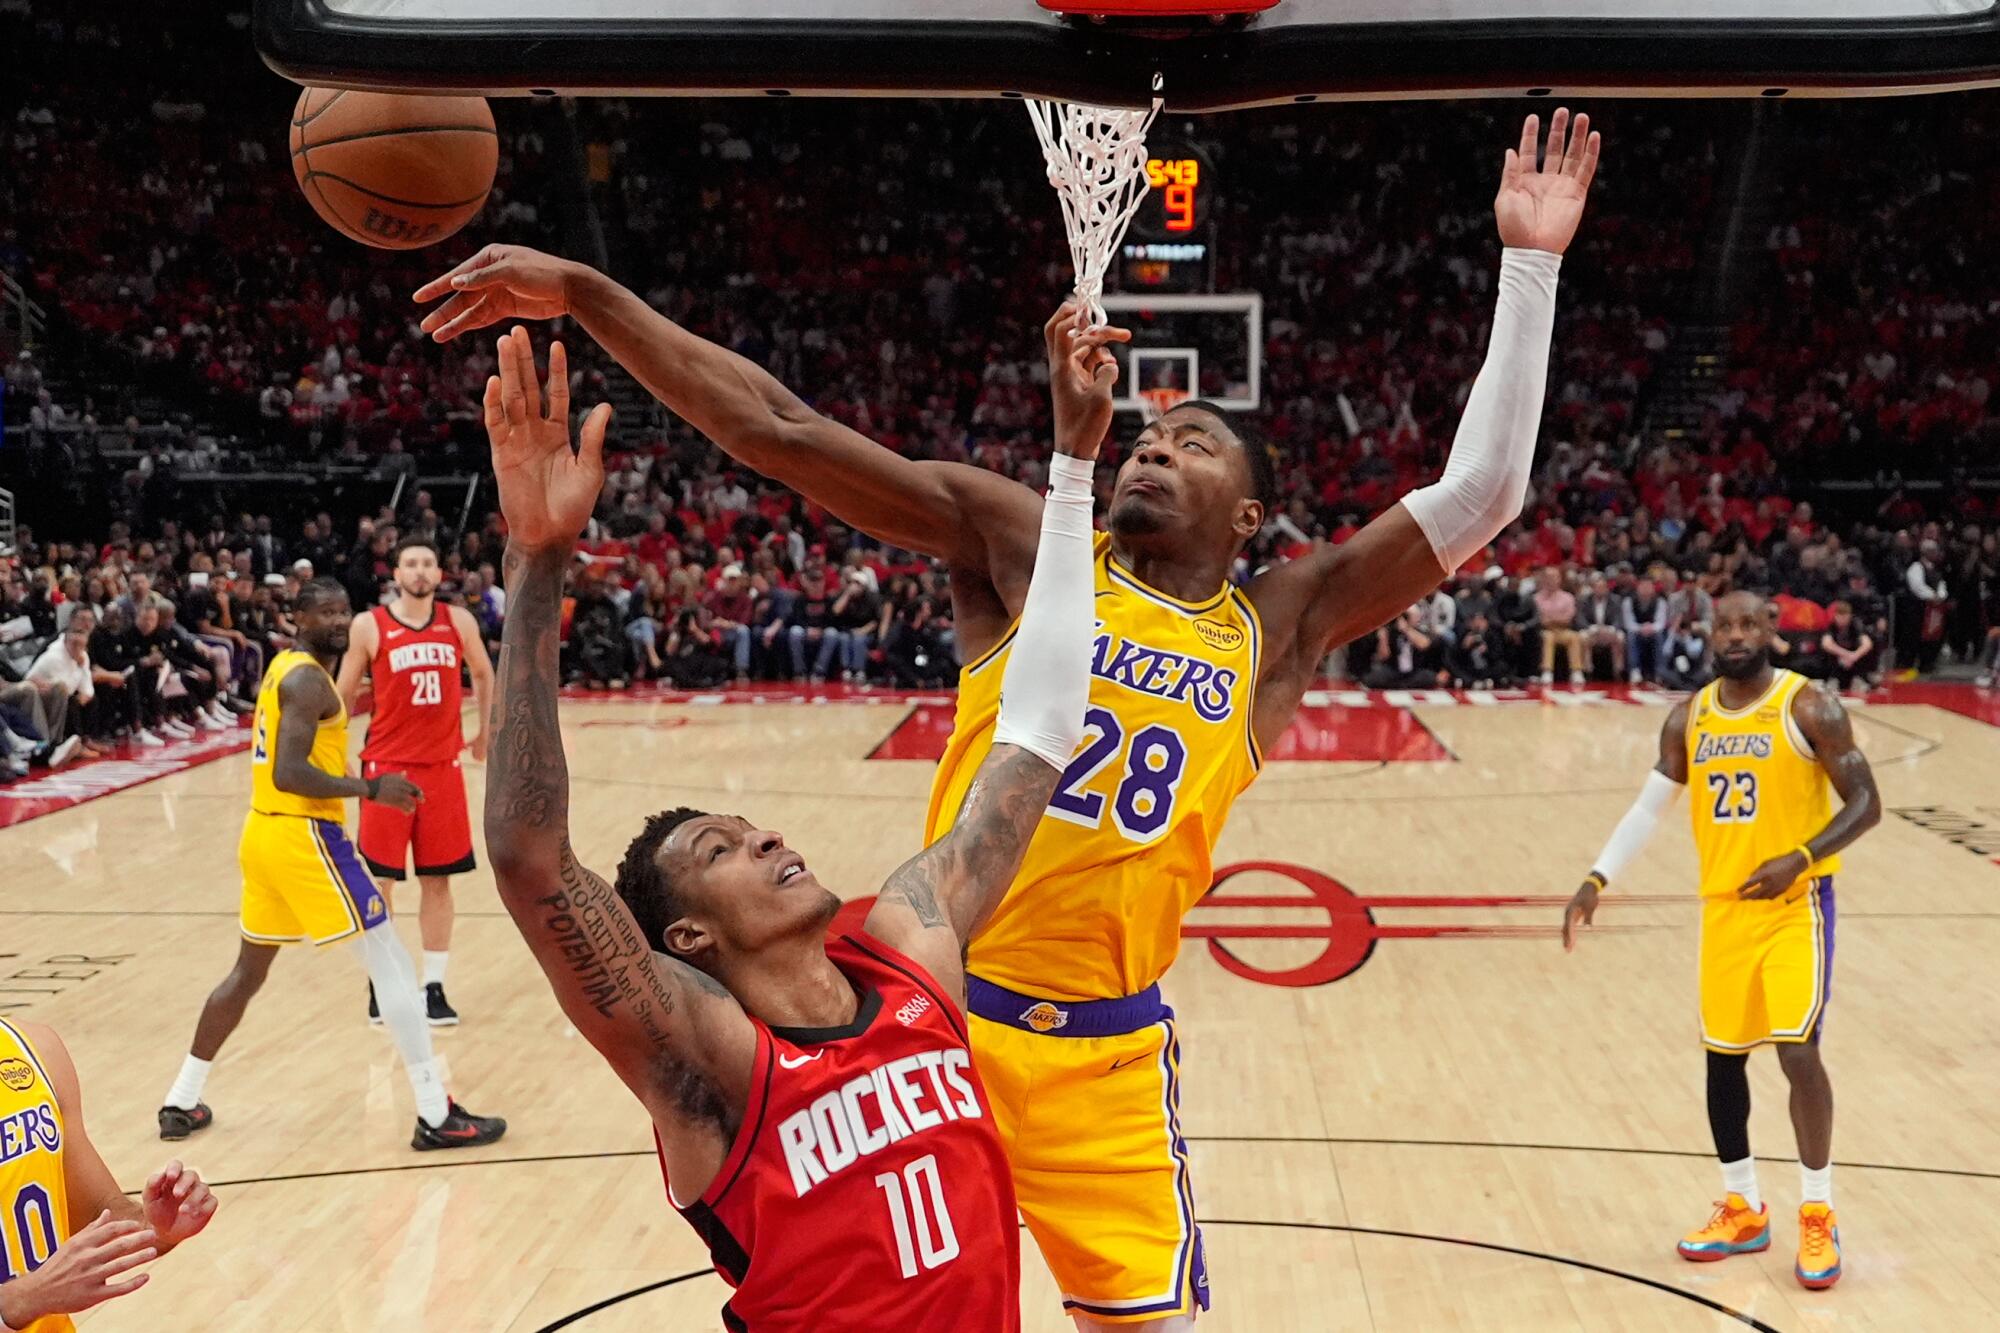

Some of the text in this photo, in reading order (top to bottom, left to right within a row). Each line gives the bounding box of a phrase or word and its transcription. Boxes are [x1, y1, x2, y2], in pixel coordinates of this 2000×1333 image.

[1165, 185, 1194, 230] 9
[389, 641, 457, 673] ROCKETS
[1196, 622, 1240, 644] bibigo
[410, 671, 442, 706] 28
[1090, 618, 1238, 724] AKERS
[1043, 703, 1187, 844] 28
[1693, 732, 1772, 765] LAKERS
[1708, 769, 1758, 823] 23
[539, 889, 624, 1020] POTENTIAL
[583, 869, 676, 1016] mplacency Breeds
[612, 962, 644, 1002] And
[1021, 1006, 1068, 1029] LAKERS
[0, 1103, 60, 1159] ERS
[777, 1048, 982, 1198] ROCKETS
[875, 1154, 960, 1279] 10
